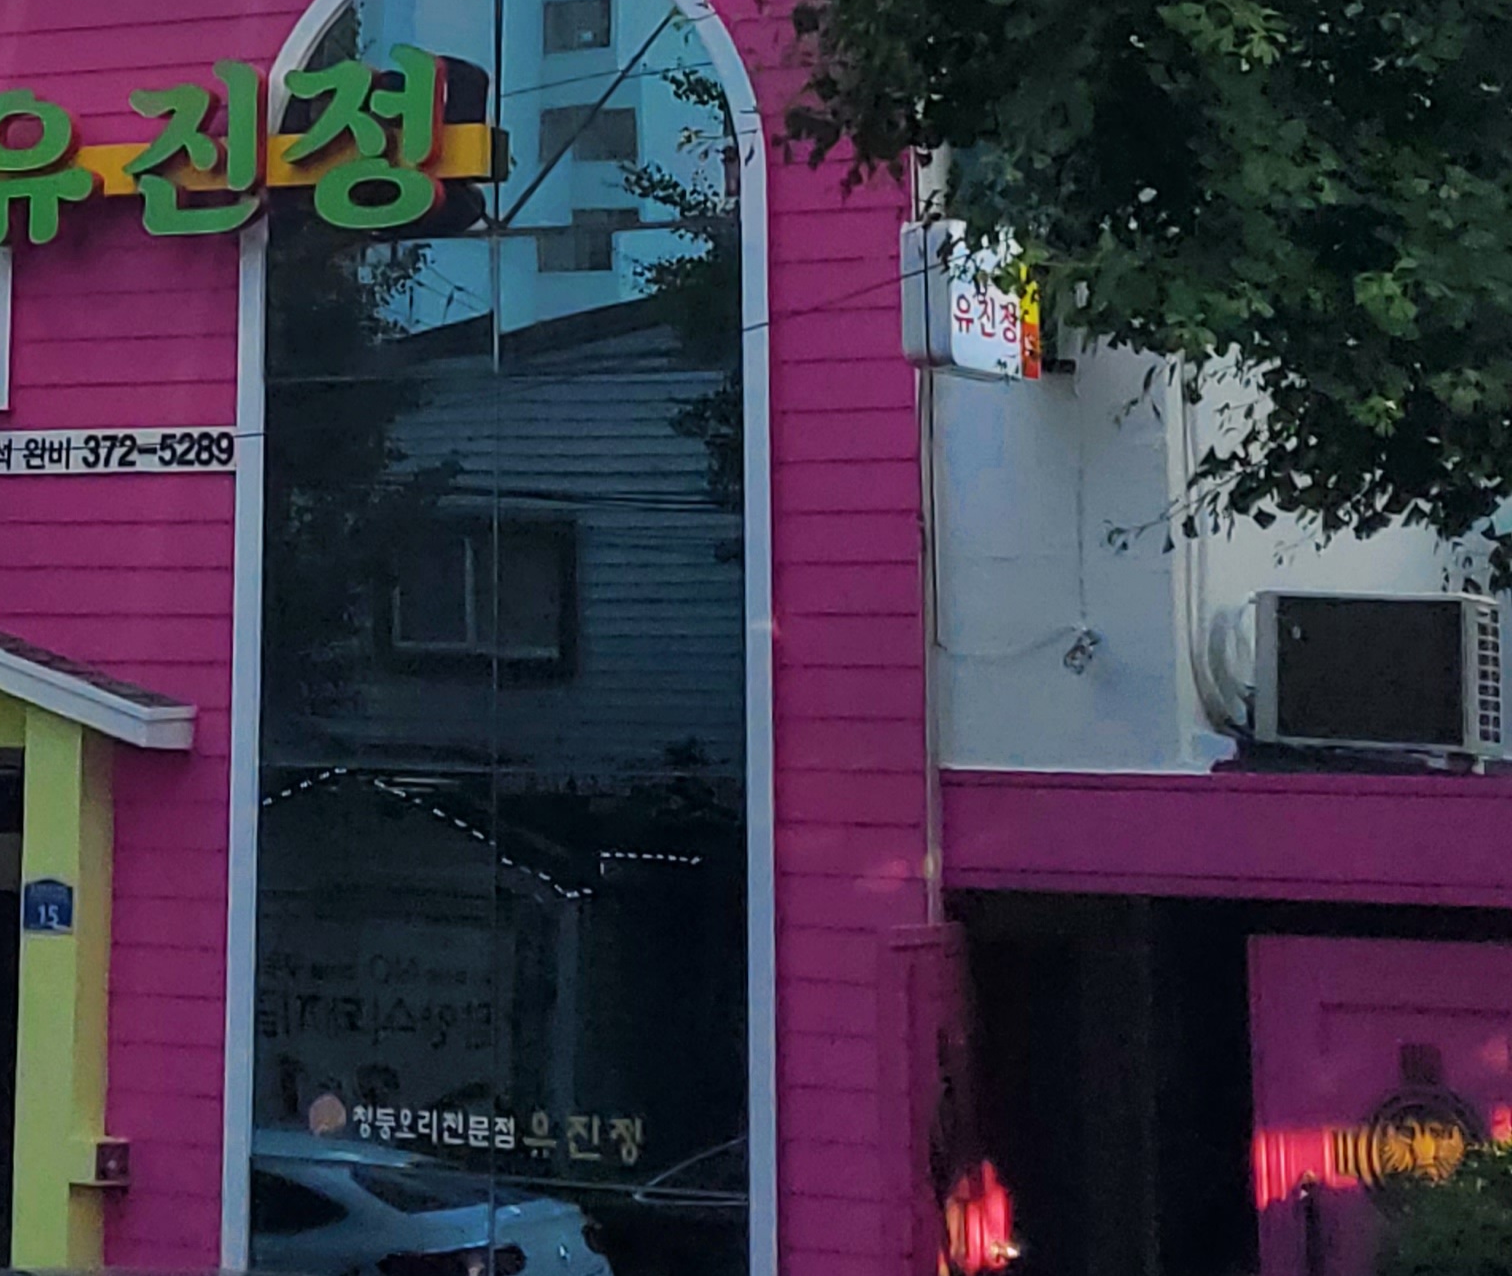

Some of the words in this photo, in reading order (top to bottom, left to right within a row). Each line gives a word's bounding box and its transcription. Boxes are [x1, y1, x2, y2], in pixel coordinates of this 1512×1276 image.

[953, 294, 1018, 343] 유진정
[22, 437, 72, 470] 완비
[82, 431, 235, 468] 372-5289
[37, 903, 61, 927] 15
